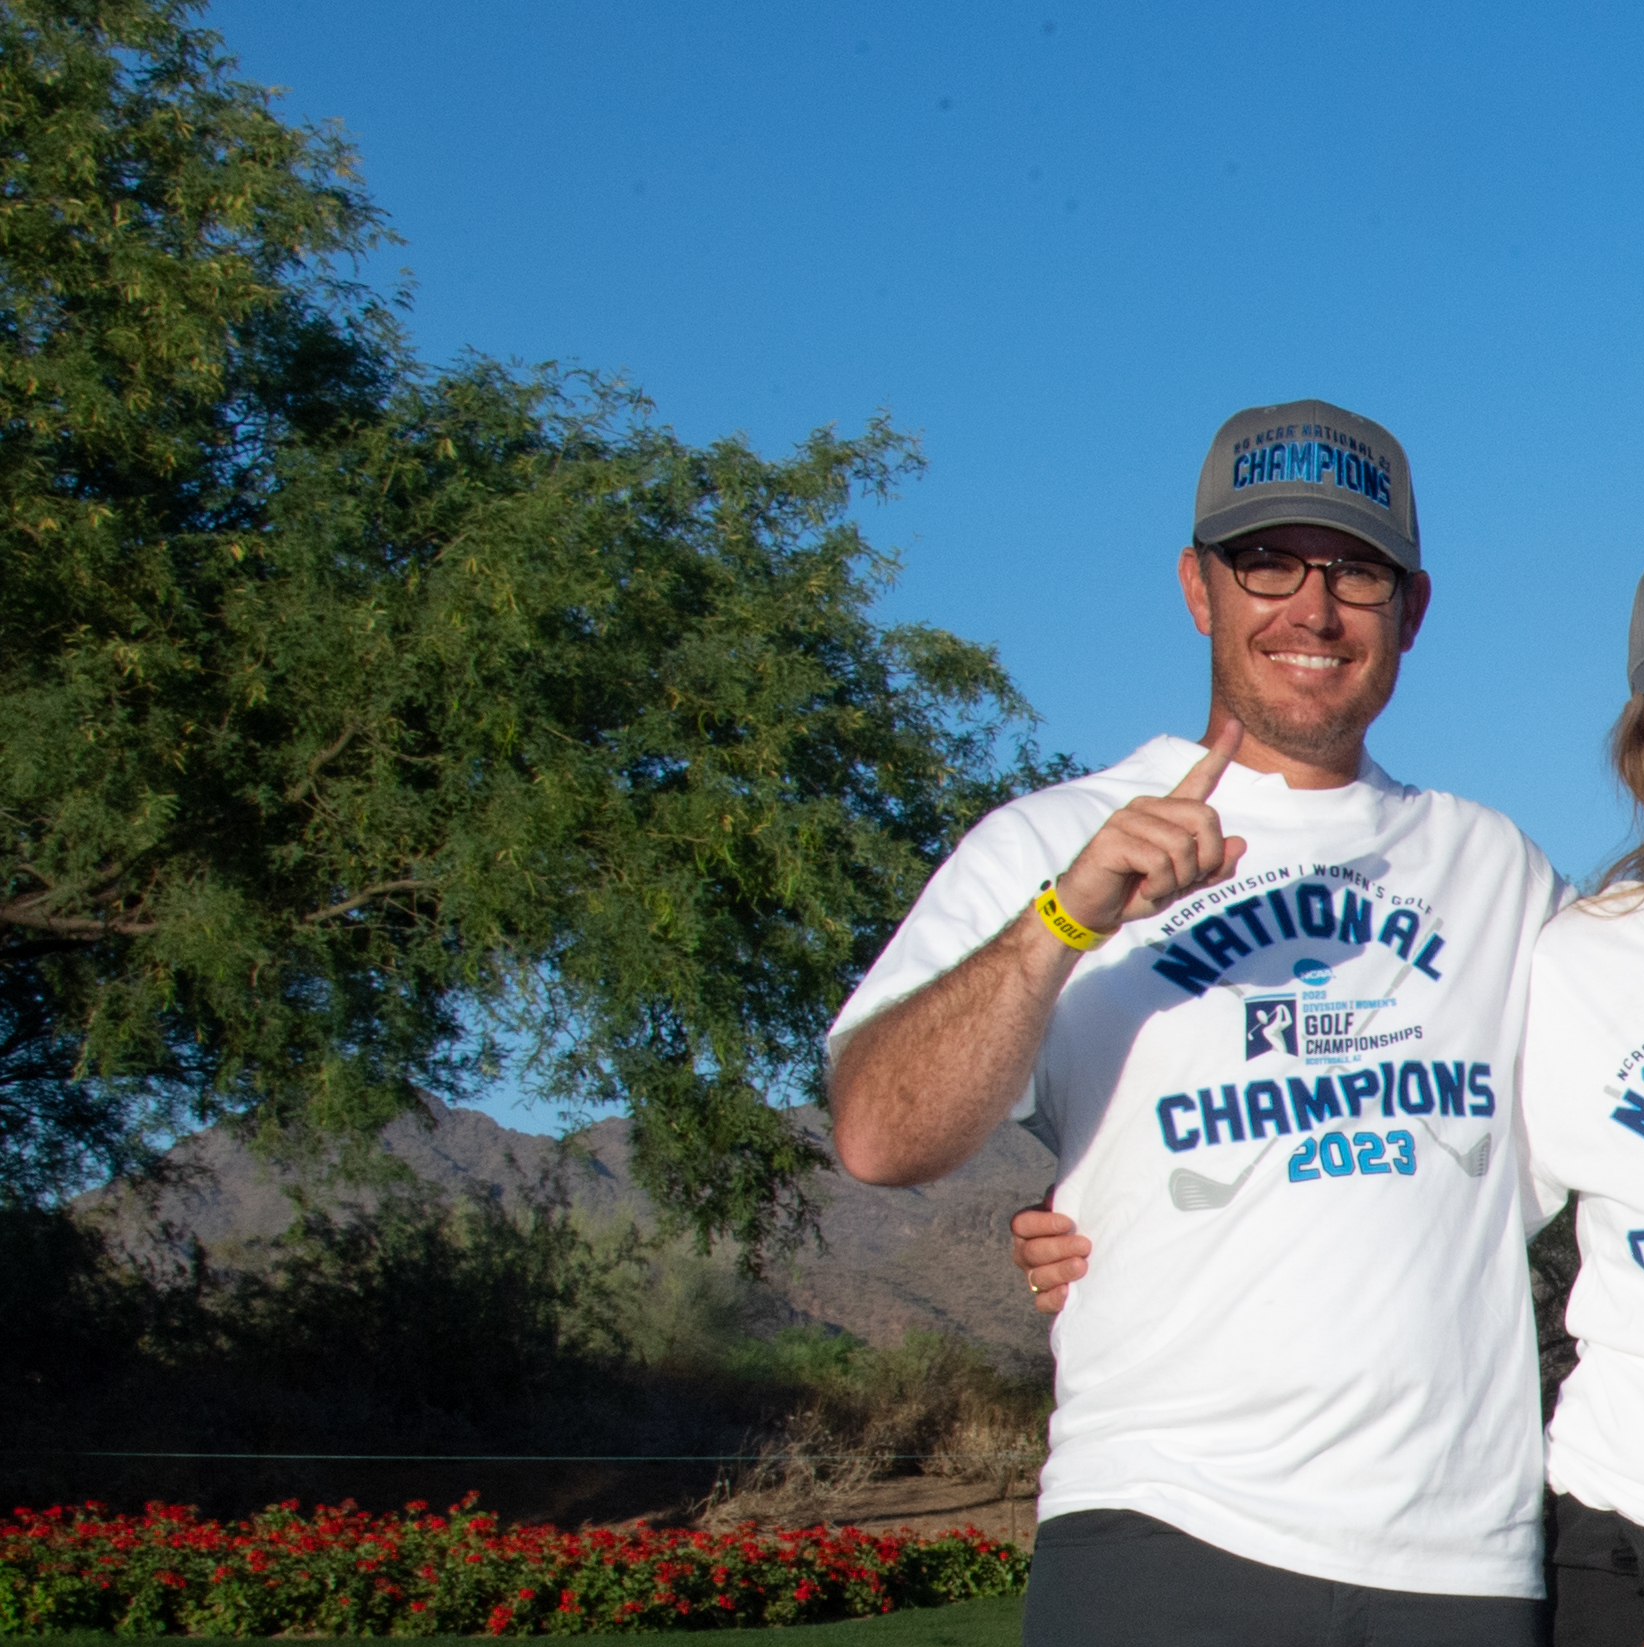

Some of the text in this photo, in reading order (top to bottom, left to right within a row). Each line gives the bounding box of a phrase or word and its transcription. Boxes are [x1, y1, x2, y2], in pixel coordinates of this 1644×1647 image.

[1233, 441, 1392, 510] CHAMPIONS
[1208, 867, 1290, 904] DIVISION
[1313, 863, 1385, 899] WOMEN'S
[1391, 895, 1434, 915] GOLF
[1053, 916, 1087, 940] GOLF
[1152, 883, 1446, 998] NATIONAL
[1302, 990, 1326, 1000] 2023
[1305, 1012, 1354, 1036] GOLF
[1306, 1025, 1423, 1055] CHAMPIONSHIPS
[1156, 1061, 1496, 1154] CHAMPIONS
[1288, 1130, 1417, 1183] 2023
